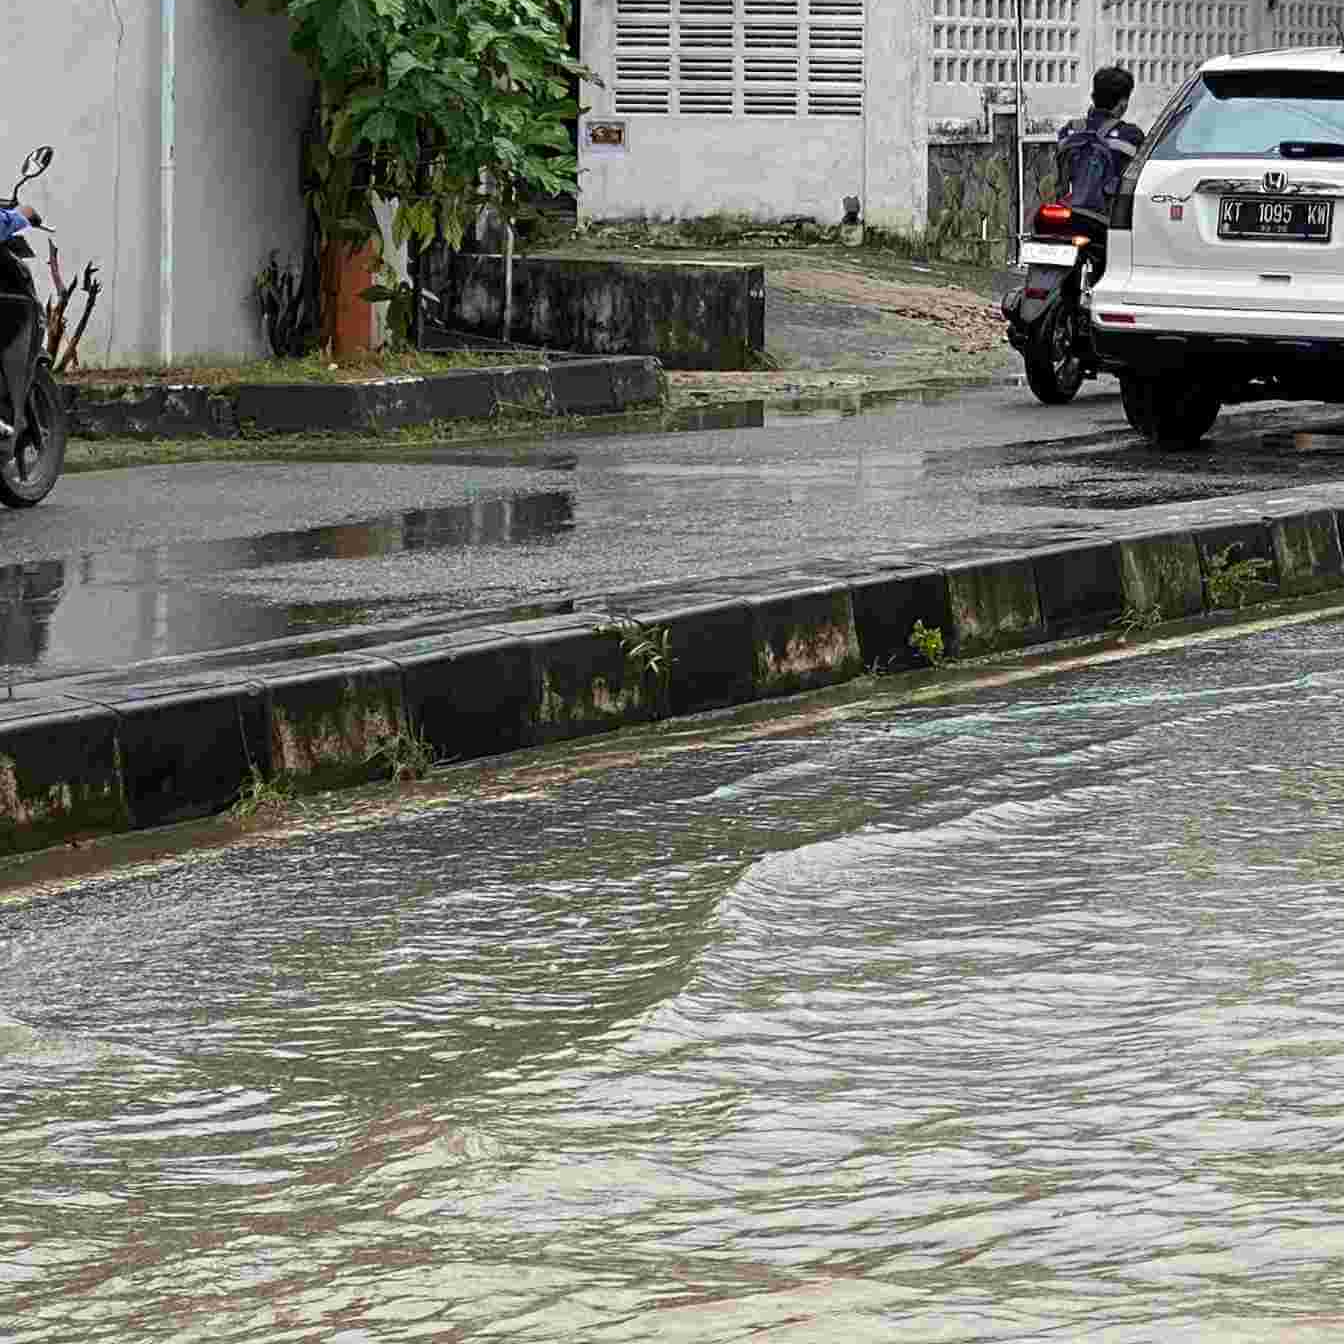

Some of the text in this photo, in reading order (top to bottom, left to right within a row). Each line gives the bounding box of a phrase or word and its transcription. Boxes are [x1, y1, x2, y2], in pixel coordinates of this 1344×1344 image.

[1223, 201, 1330, 225] KT 1095 KW
